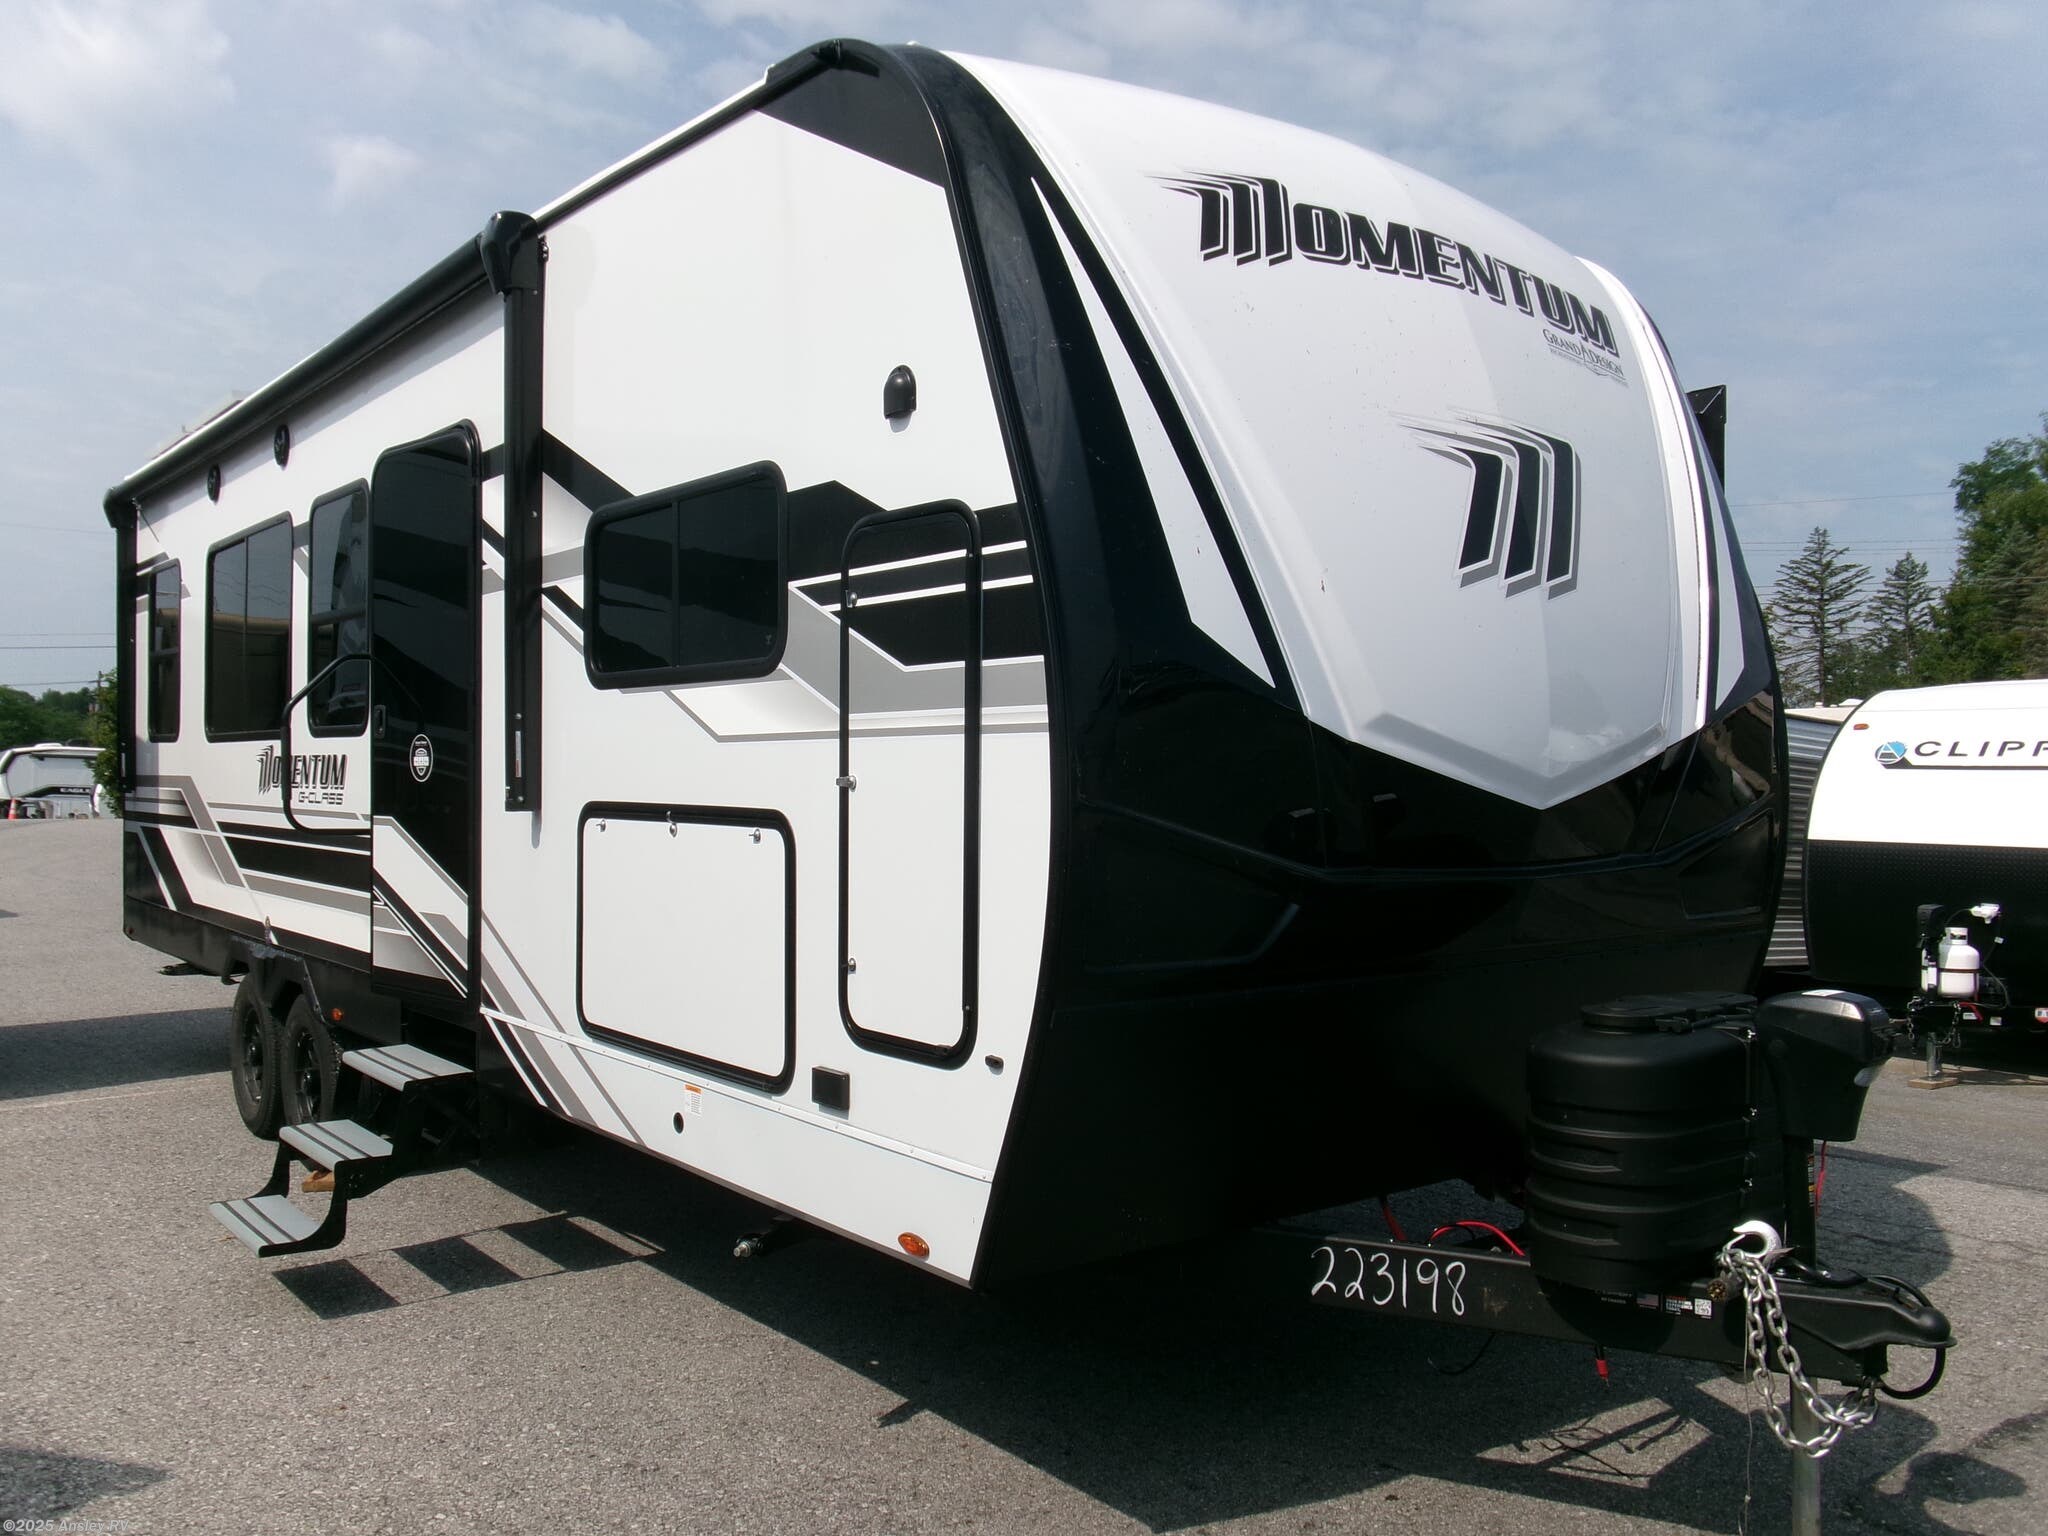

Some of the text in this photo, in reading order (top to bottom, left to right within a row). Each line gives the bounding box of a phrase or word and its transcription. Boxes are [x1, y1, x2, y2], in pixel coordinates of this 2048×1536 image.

[1150, 172, 1620, 358] MOMENTUM
[256, 744, 347, 795] MOENTUM
[1310, 1246, 1467, 1316] 223198
